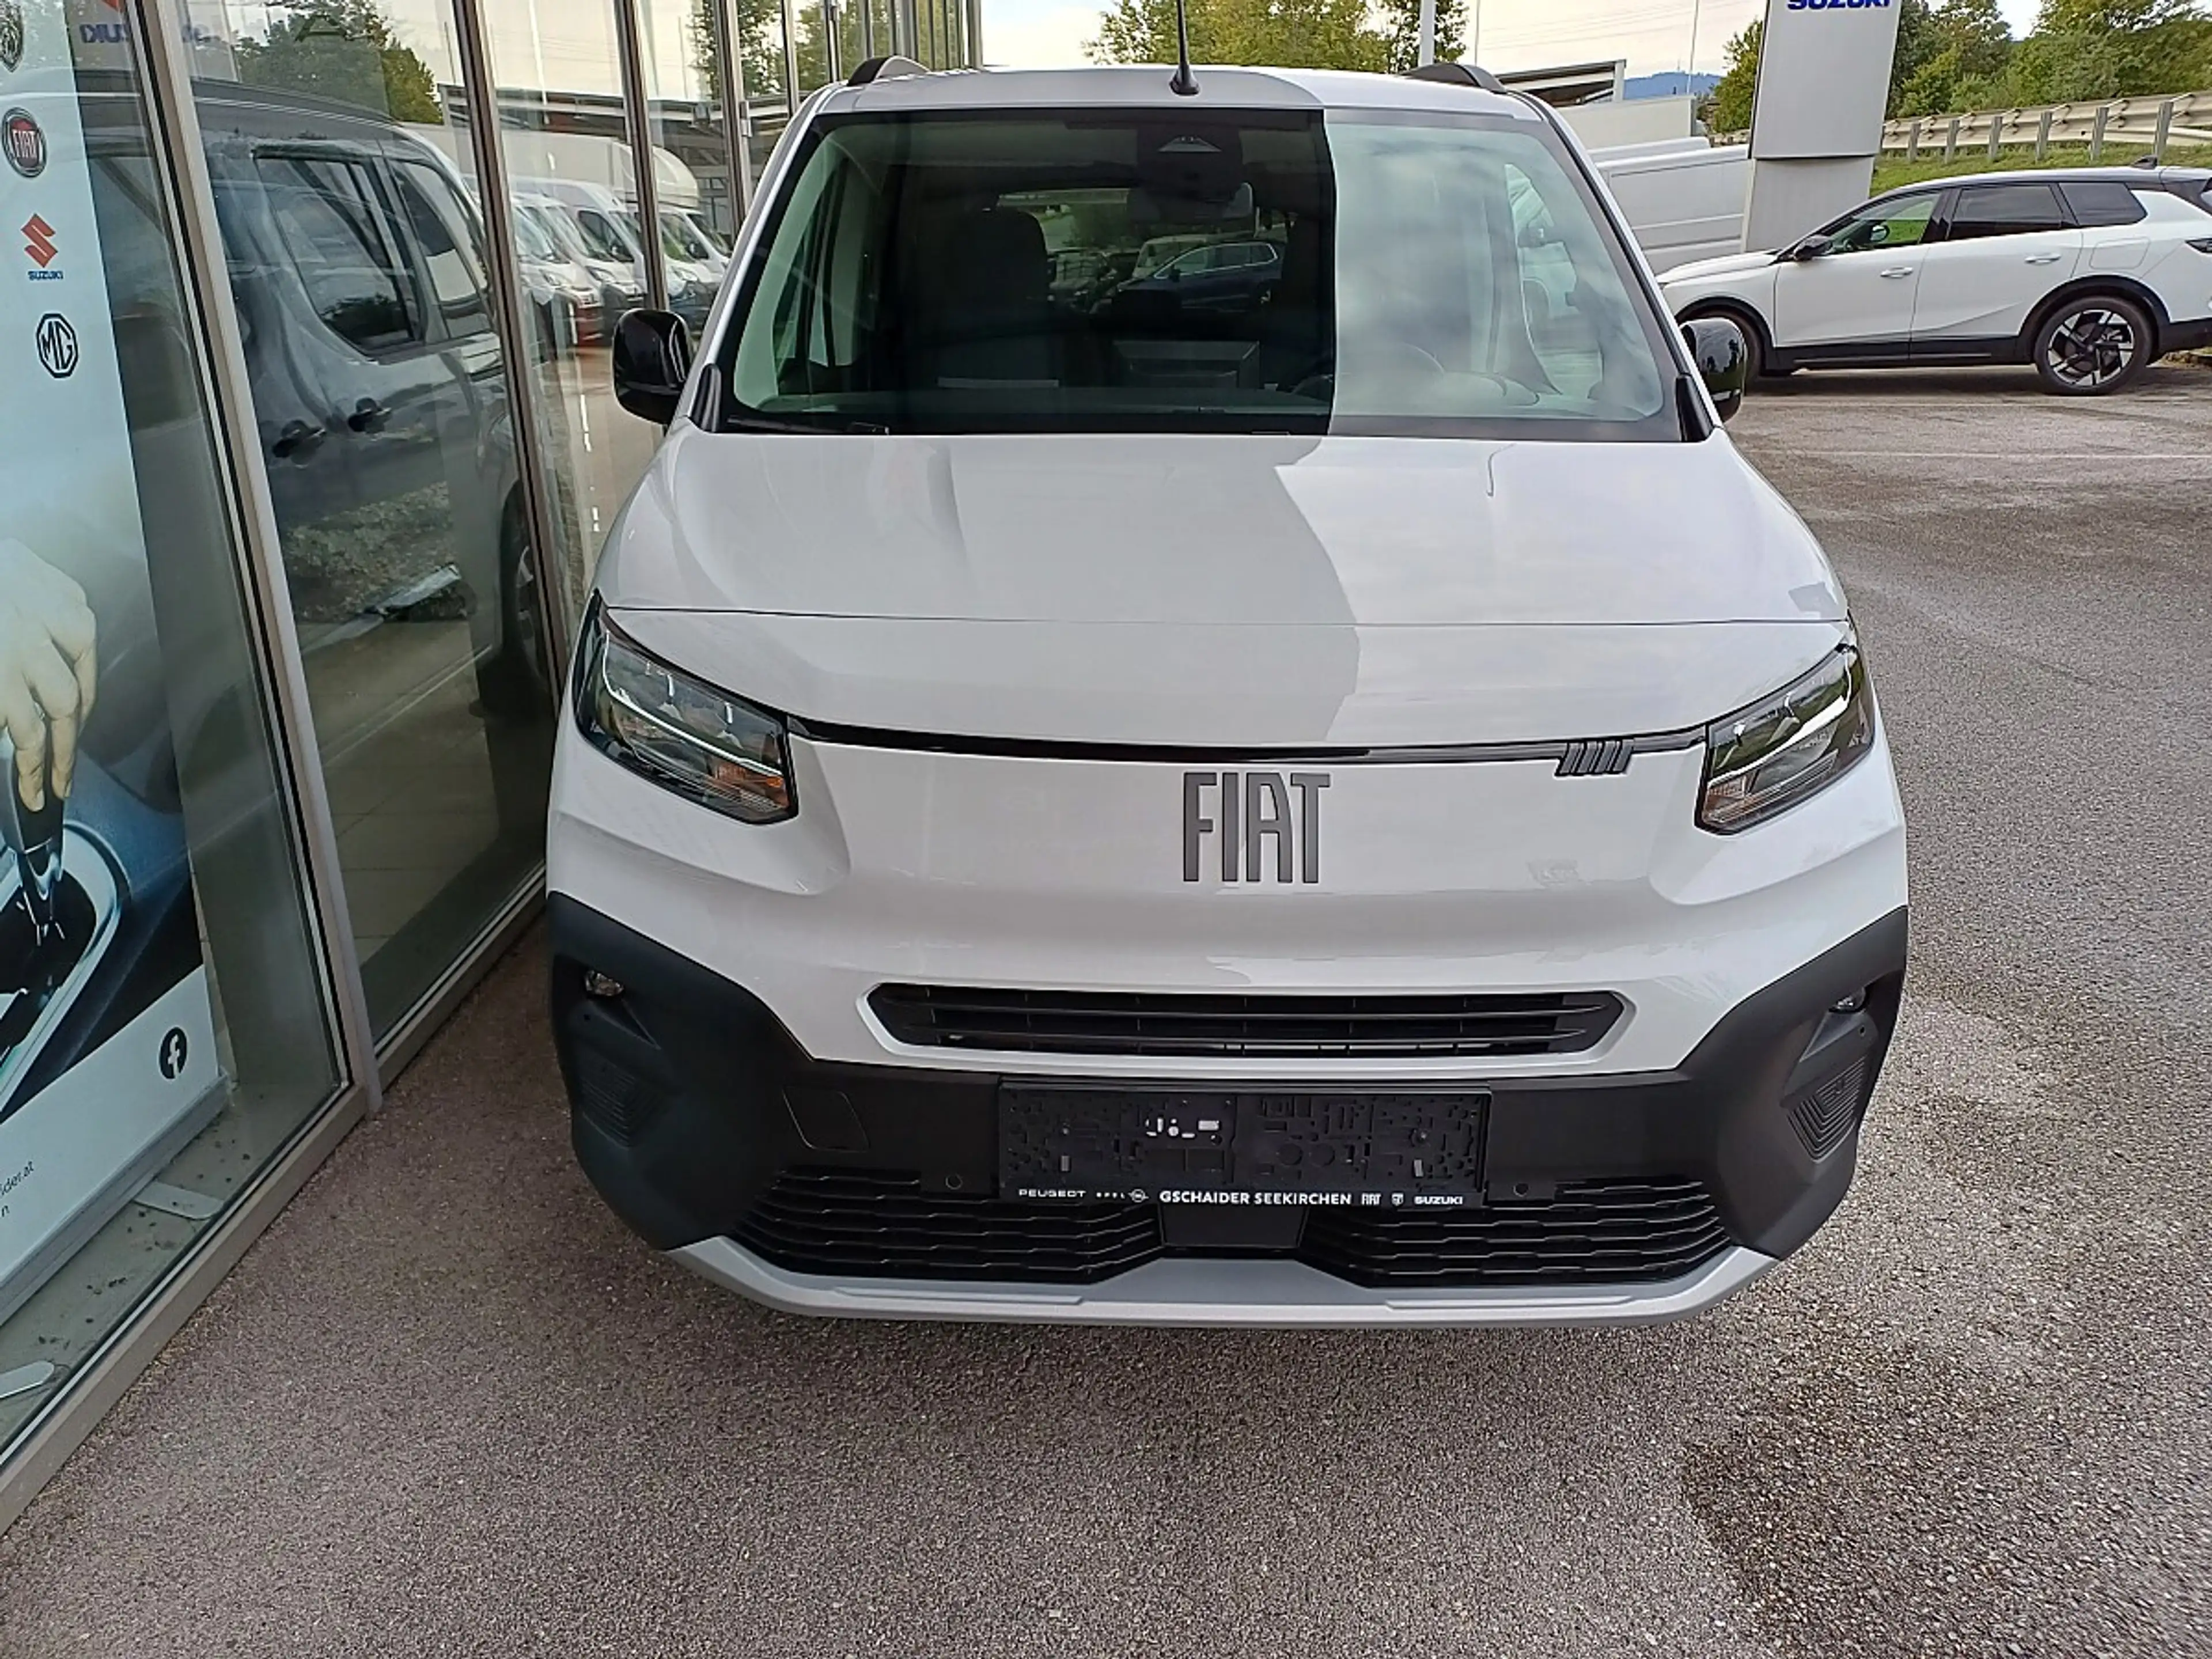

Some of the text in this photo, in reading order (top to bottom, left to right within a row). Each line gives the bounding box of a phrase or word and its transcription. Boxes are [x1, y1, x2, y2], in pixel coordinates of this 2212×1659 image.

[12, 129, 37, 158] FIAT
[41, 320, 73, 370] MG
[1183, 772, 1331, 883] FIAT
[1018, 1188, 1087, 1198] PEUGEOT
[1160, 1190, 1249, 1205] GSCHAIDER
[1254, 1192, 1352, 1205] SEEKIRCHEN
[1414, 1195, 1464, 1205] SUZUKI
